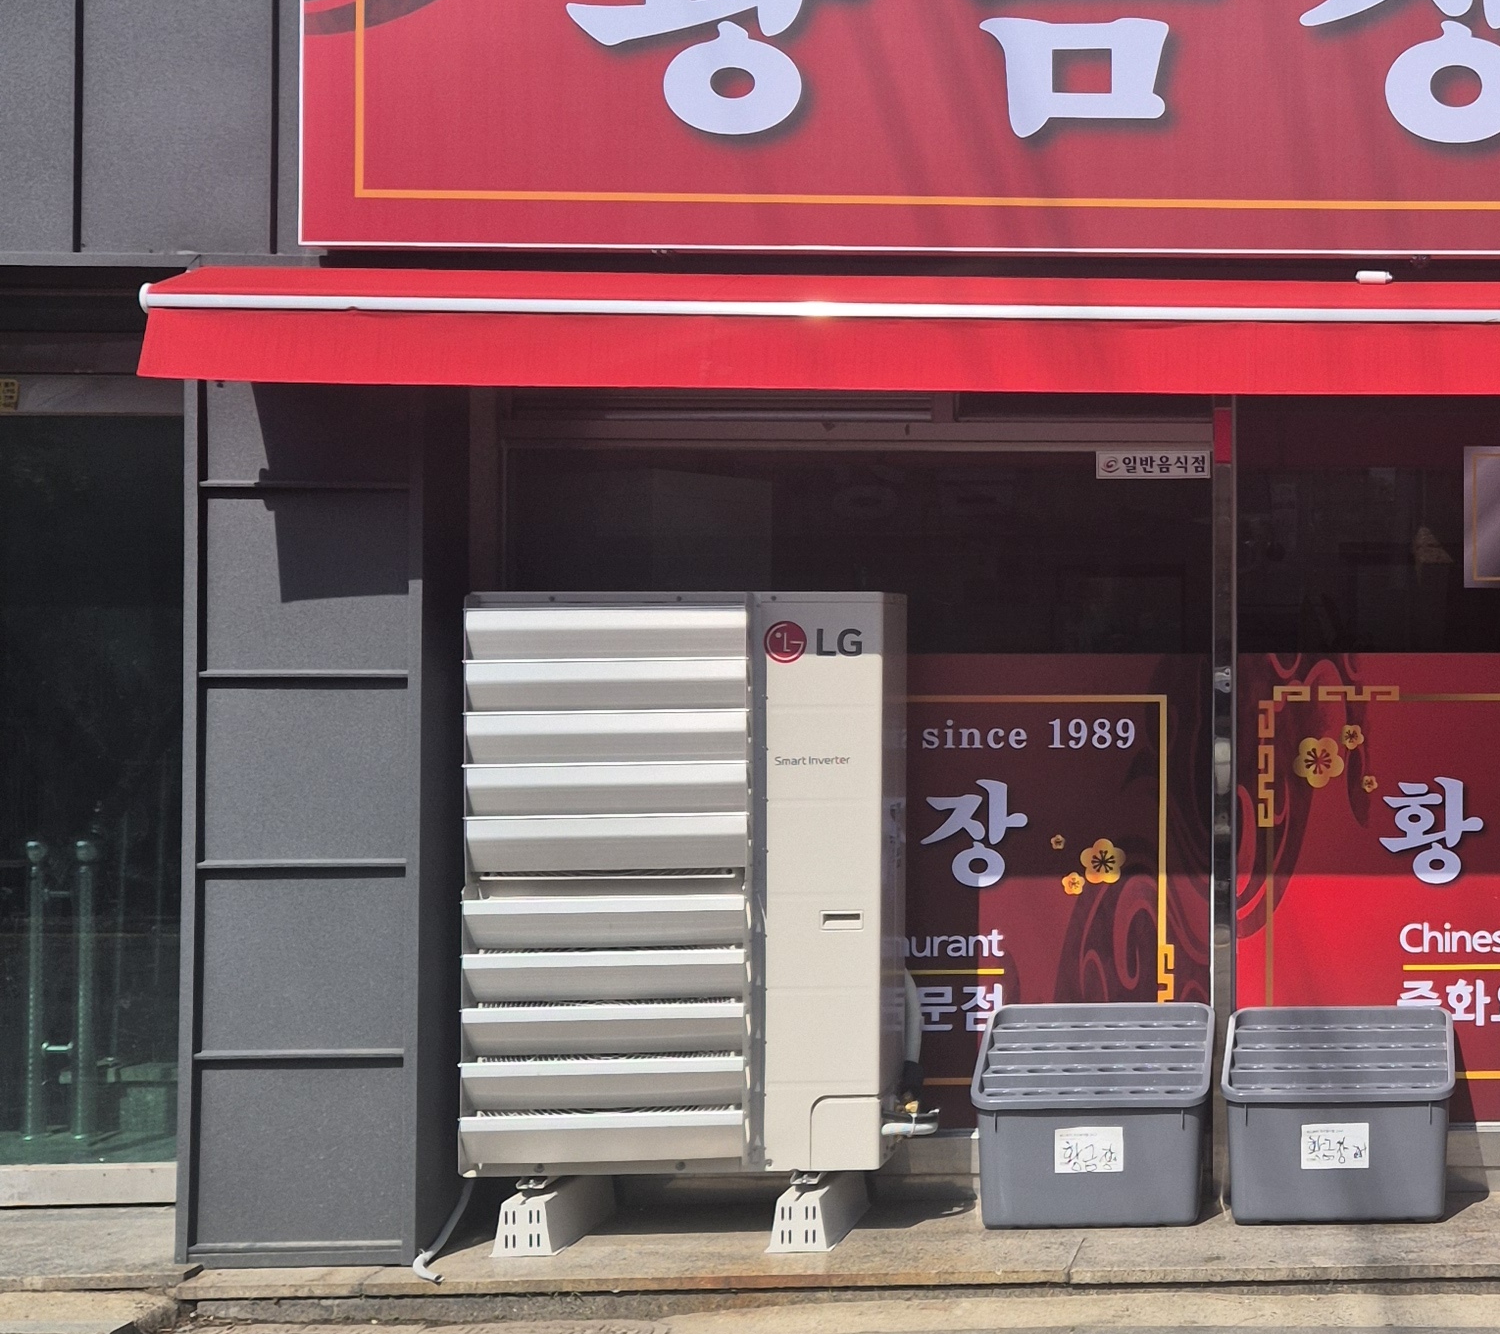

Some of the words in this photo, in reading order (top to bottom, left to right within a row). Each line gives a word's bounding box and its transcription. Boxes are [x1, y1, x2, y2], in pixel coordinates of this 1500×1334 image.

[1122, 455, 1206, 474] 일반음식점
[816, 628, 863, 657] LG
[921, 720, 1028, 750] since
[1047, 718, 1136, 750] 1989
[774, 756, 807, 766] Smart
[808, 756, 850, 766] Inverter
